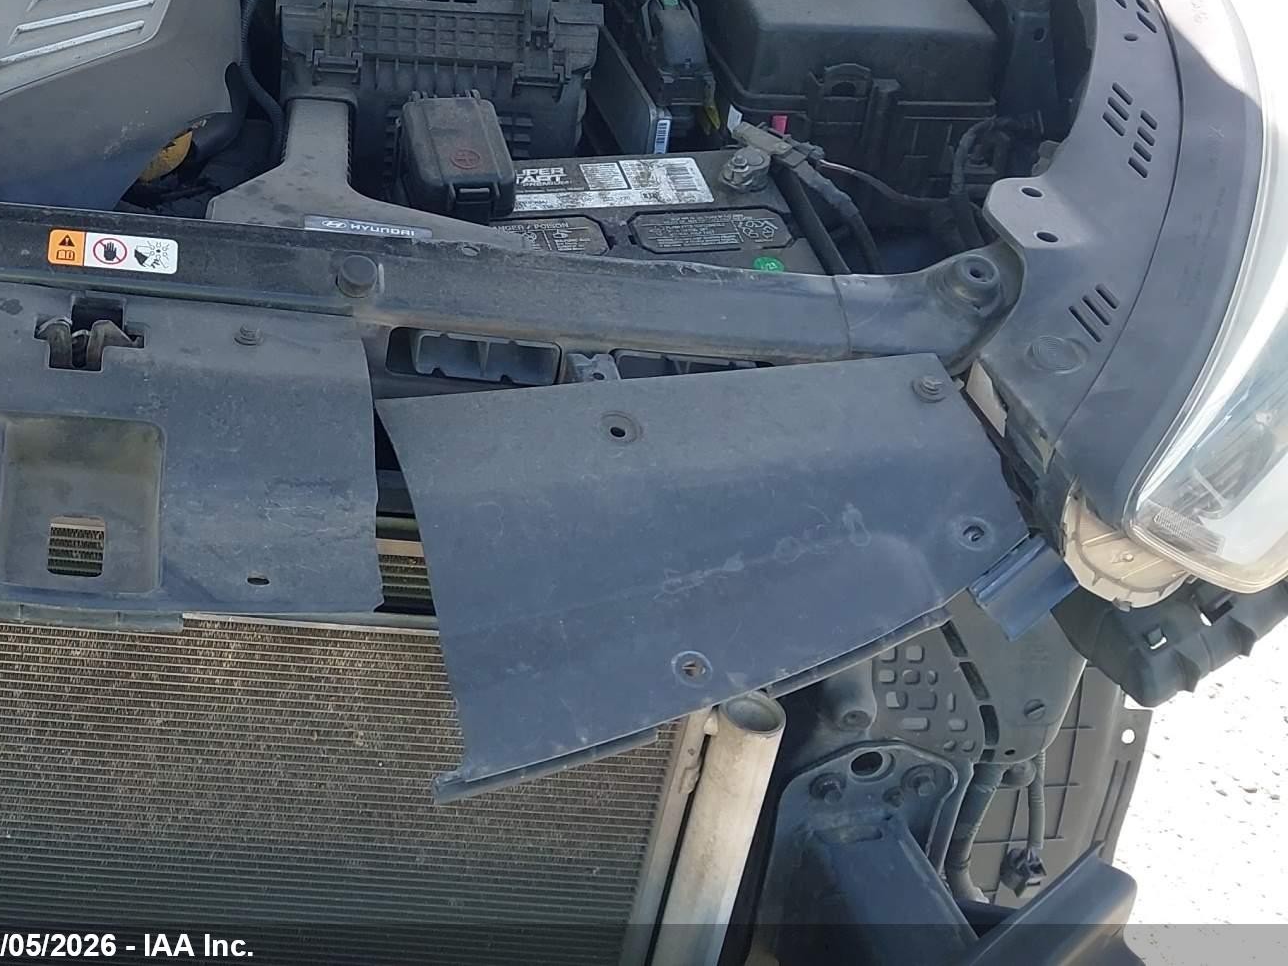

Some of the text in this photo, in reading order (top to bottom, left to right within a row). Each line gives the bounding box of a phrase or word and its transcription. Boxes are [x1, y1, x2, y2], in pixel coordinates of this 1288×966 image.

[515, 167, 564, 176] UPER
[351, 224, 415, 236] HYUNDAI
[534, 221, 569, 230] POISON
